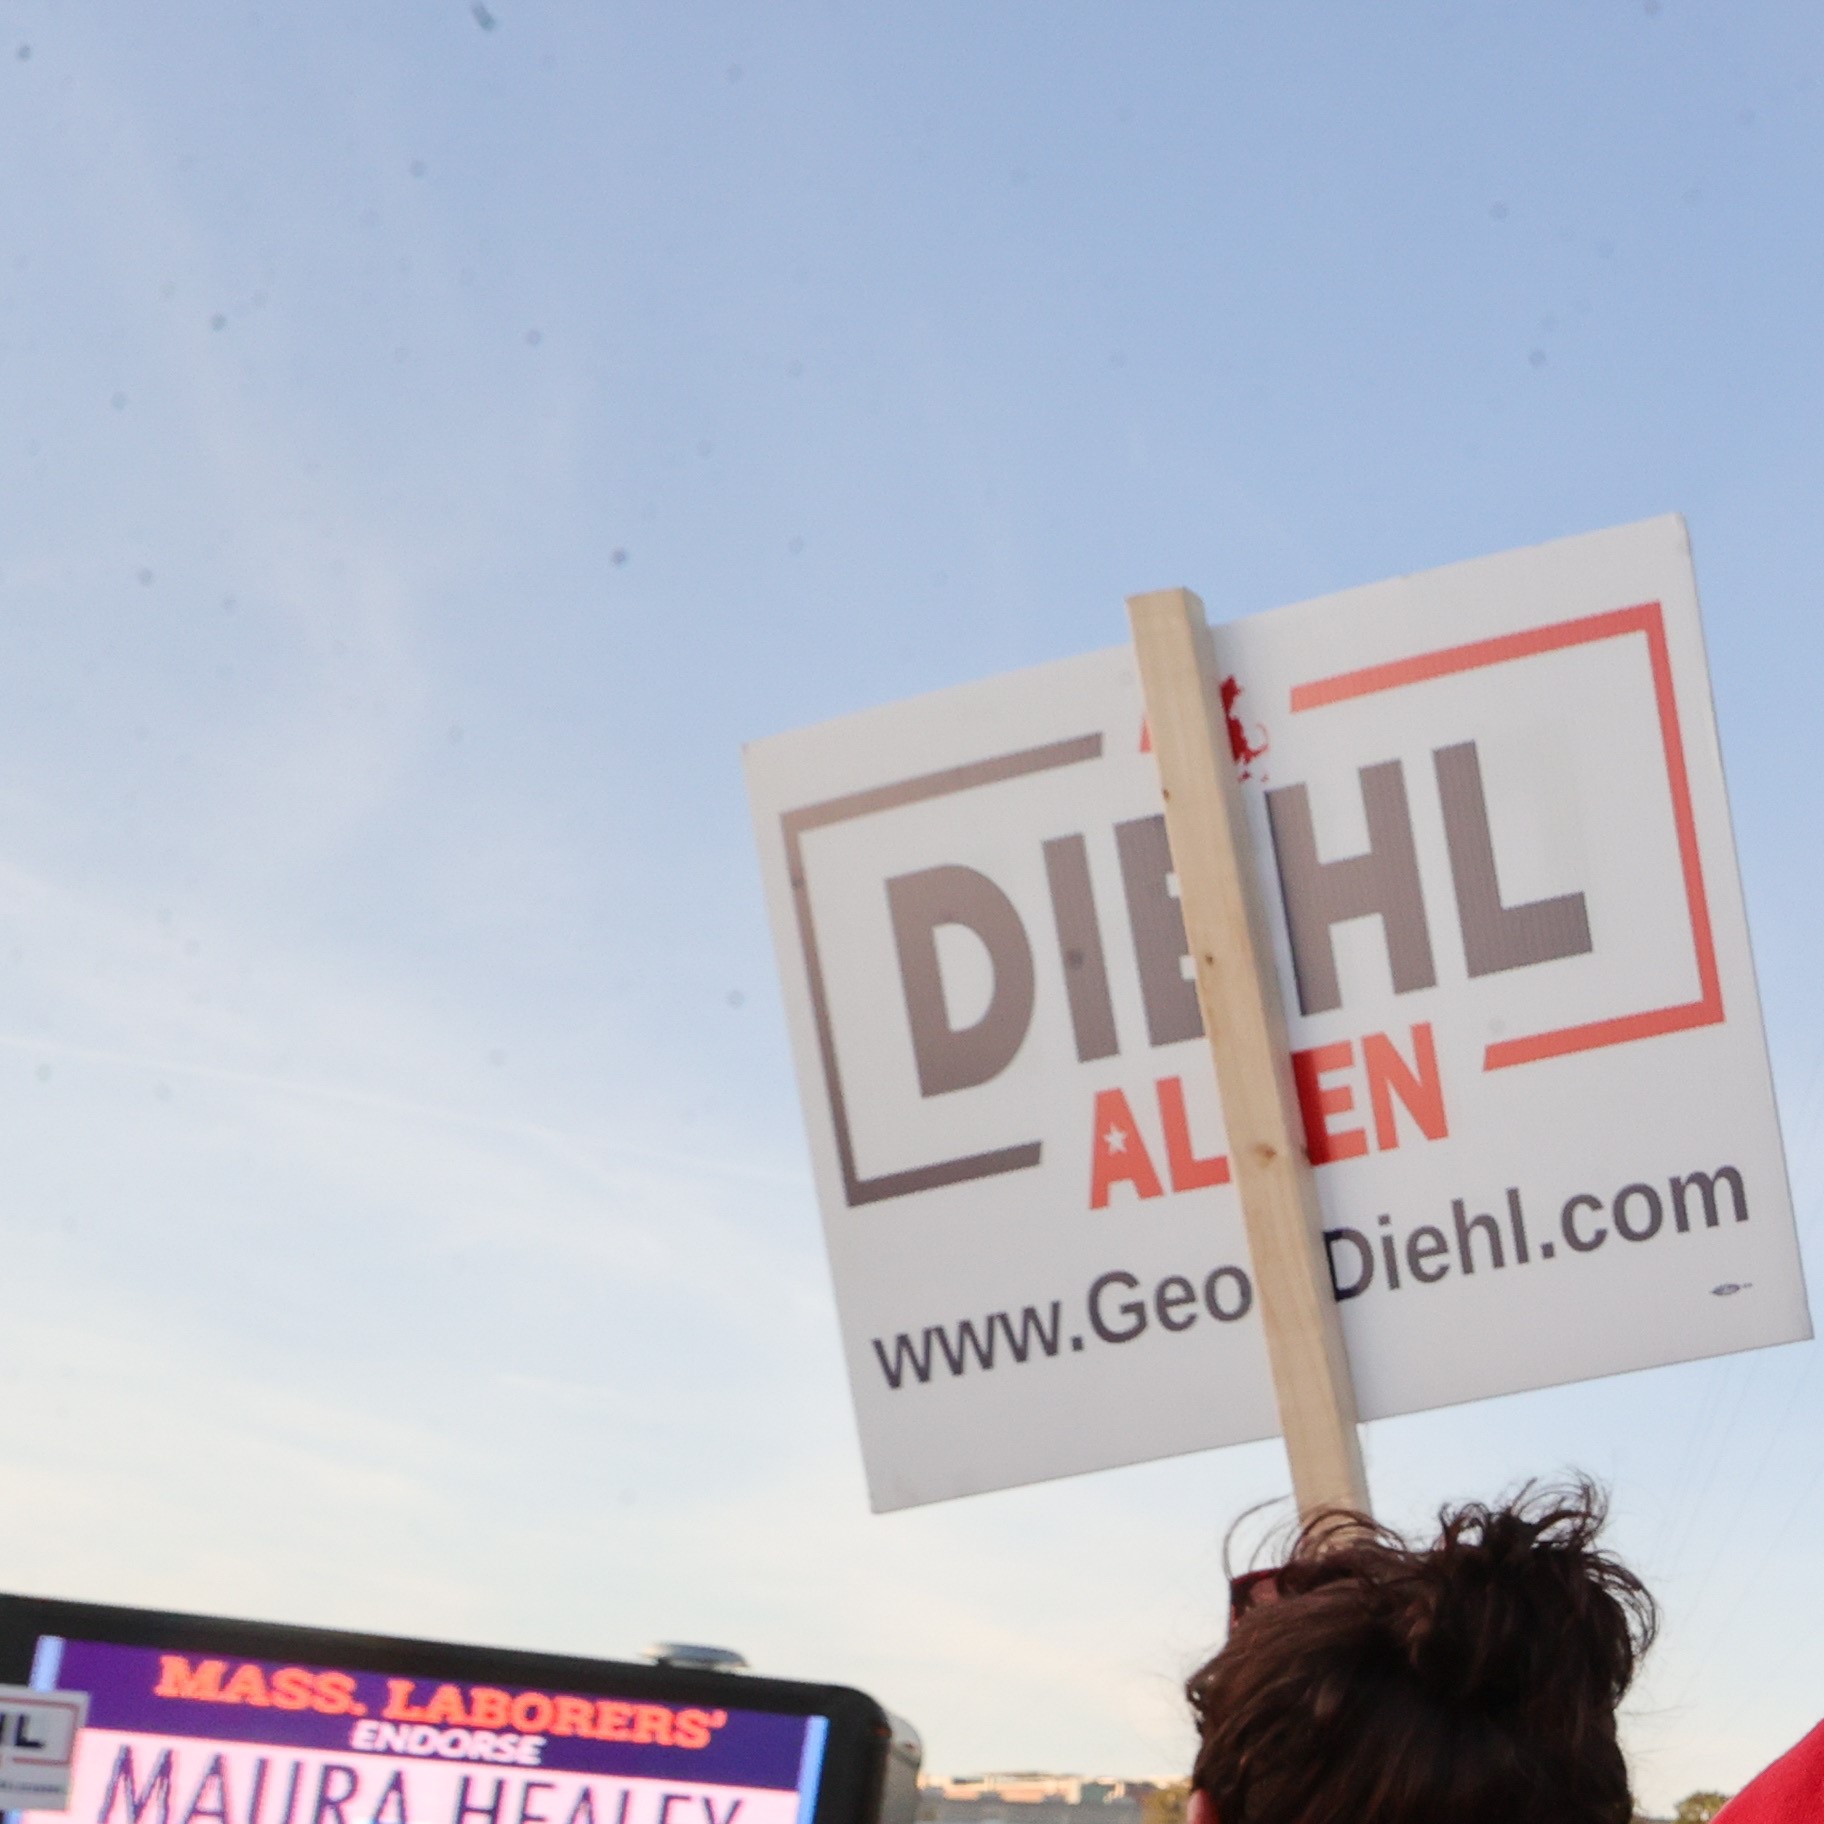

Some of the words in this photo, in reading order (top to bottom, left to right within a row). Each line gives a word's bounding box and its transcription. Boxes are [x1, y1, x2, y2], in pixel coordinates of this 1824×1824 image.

[1089, 1022, 1450, 1210] ALEN
[872, 1164, 1750, 1389] www.GeoDiehl.com
[154, 1654, 368, 1719] MASS.
[382, 1678, 728, 1750] LABORERS'
[350, 1719, 548, 1767] ENDORSE
